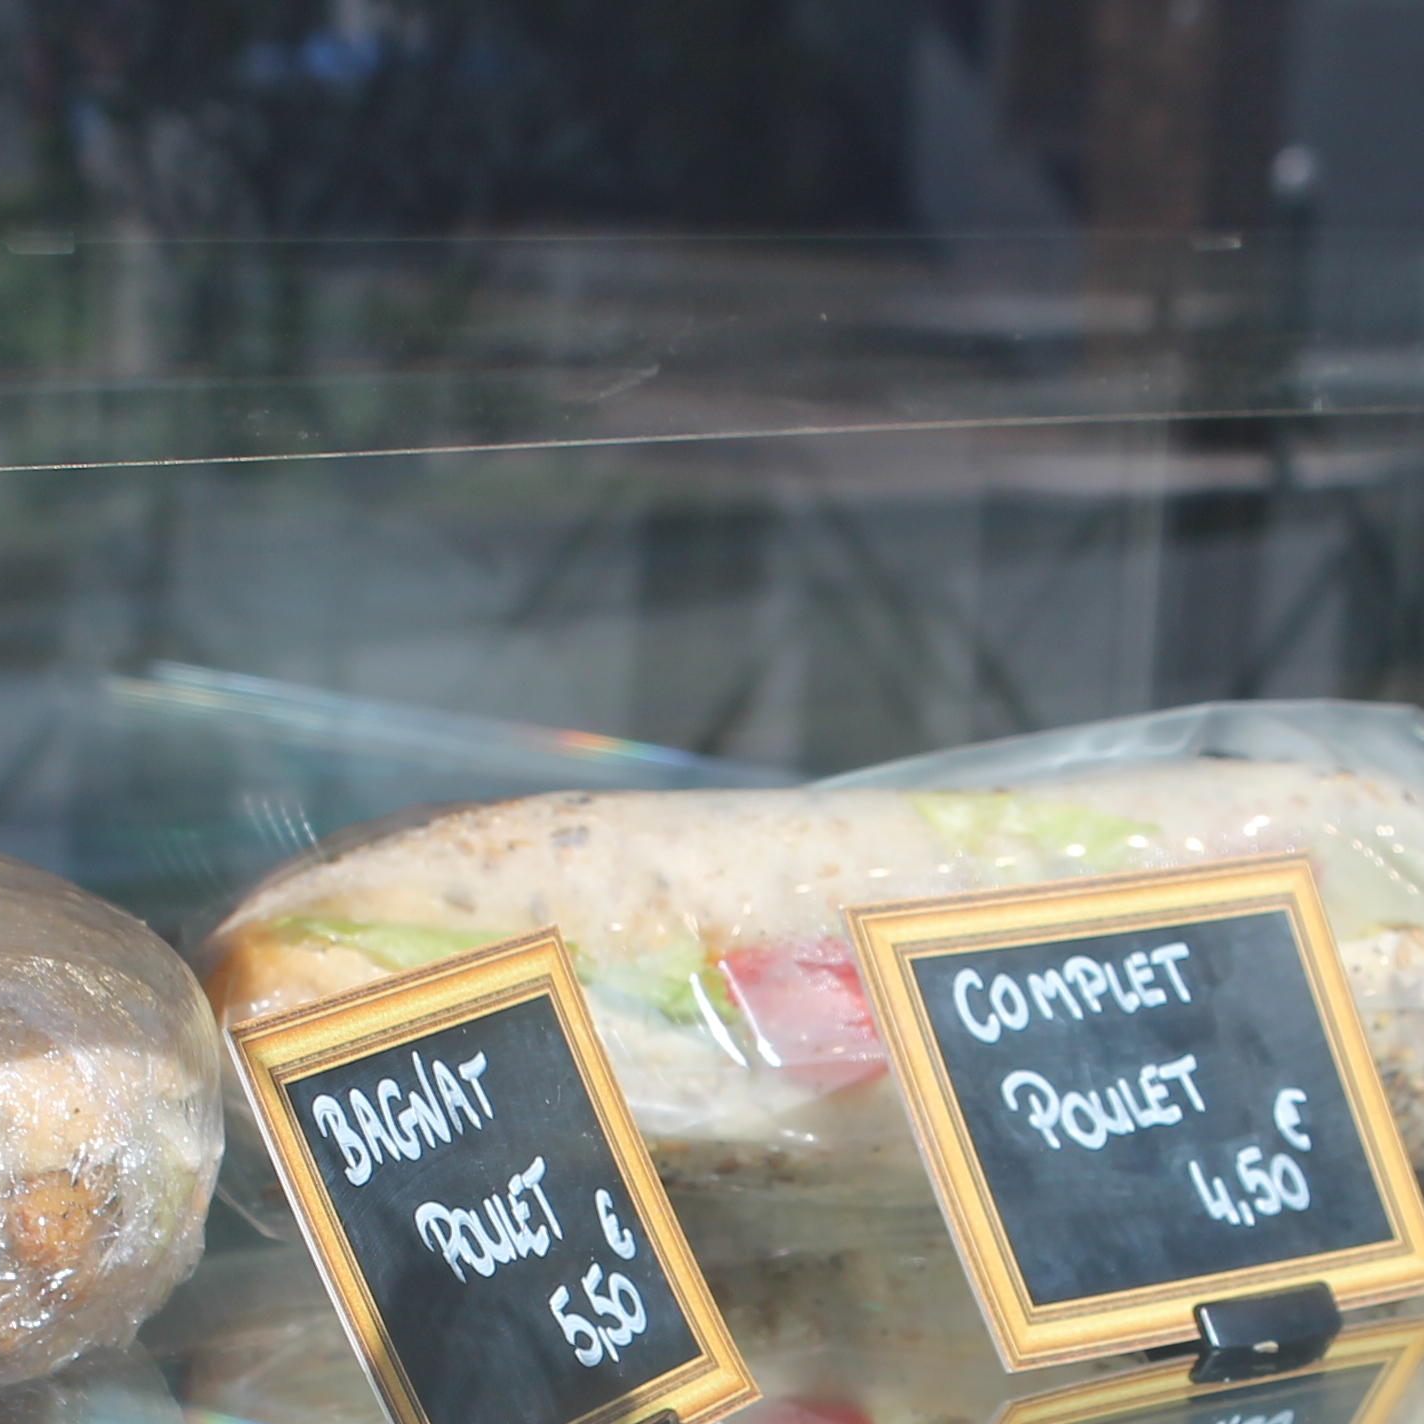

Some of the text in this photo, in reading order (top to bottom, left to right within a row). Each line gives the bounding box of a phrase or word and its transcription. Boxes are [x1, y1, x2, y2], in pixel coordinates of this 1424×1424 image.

[952, 941, 1192, 1044] COMPLET
[311, 1048, 496, 1188] BAGNAT
[1000, 1053, 1206, 1151] POULET
[413, 1155, 564, 1285] POULET
[1189, 1145, 1312, 1228] 4,50
[548, 1261, 649, 1369] 5,50
